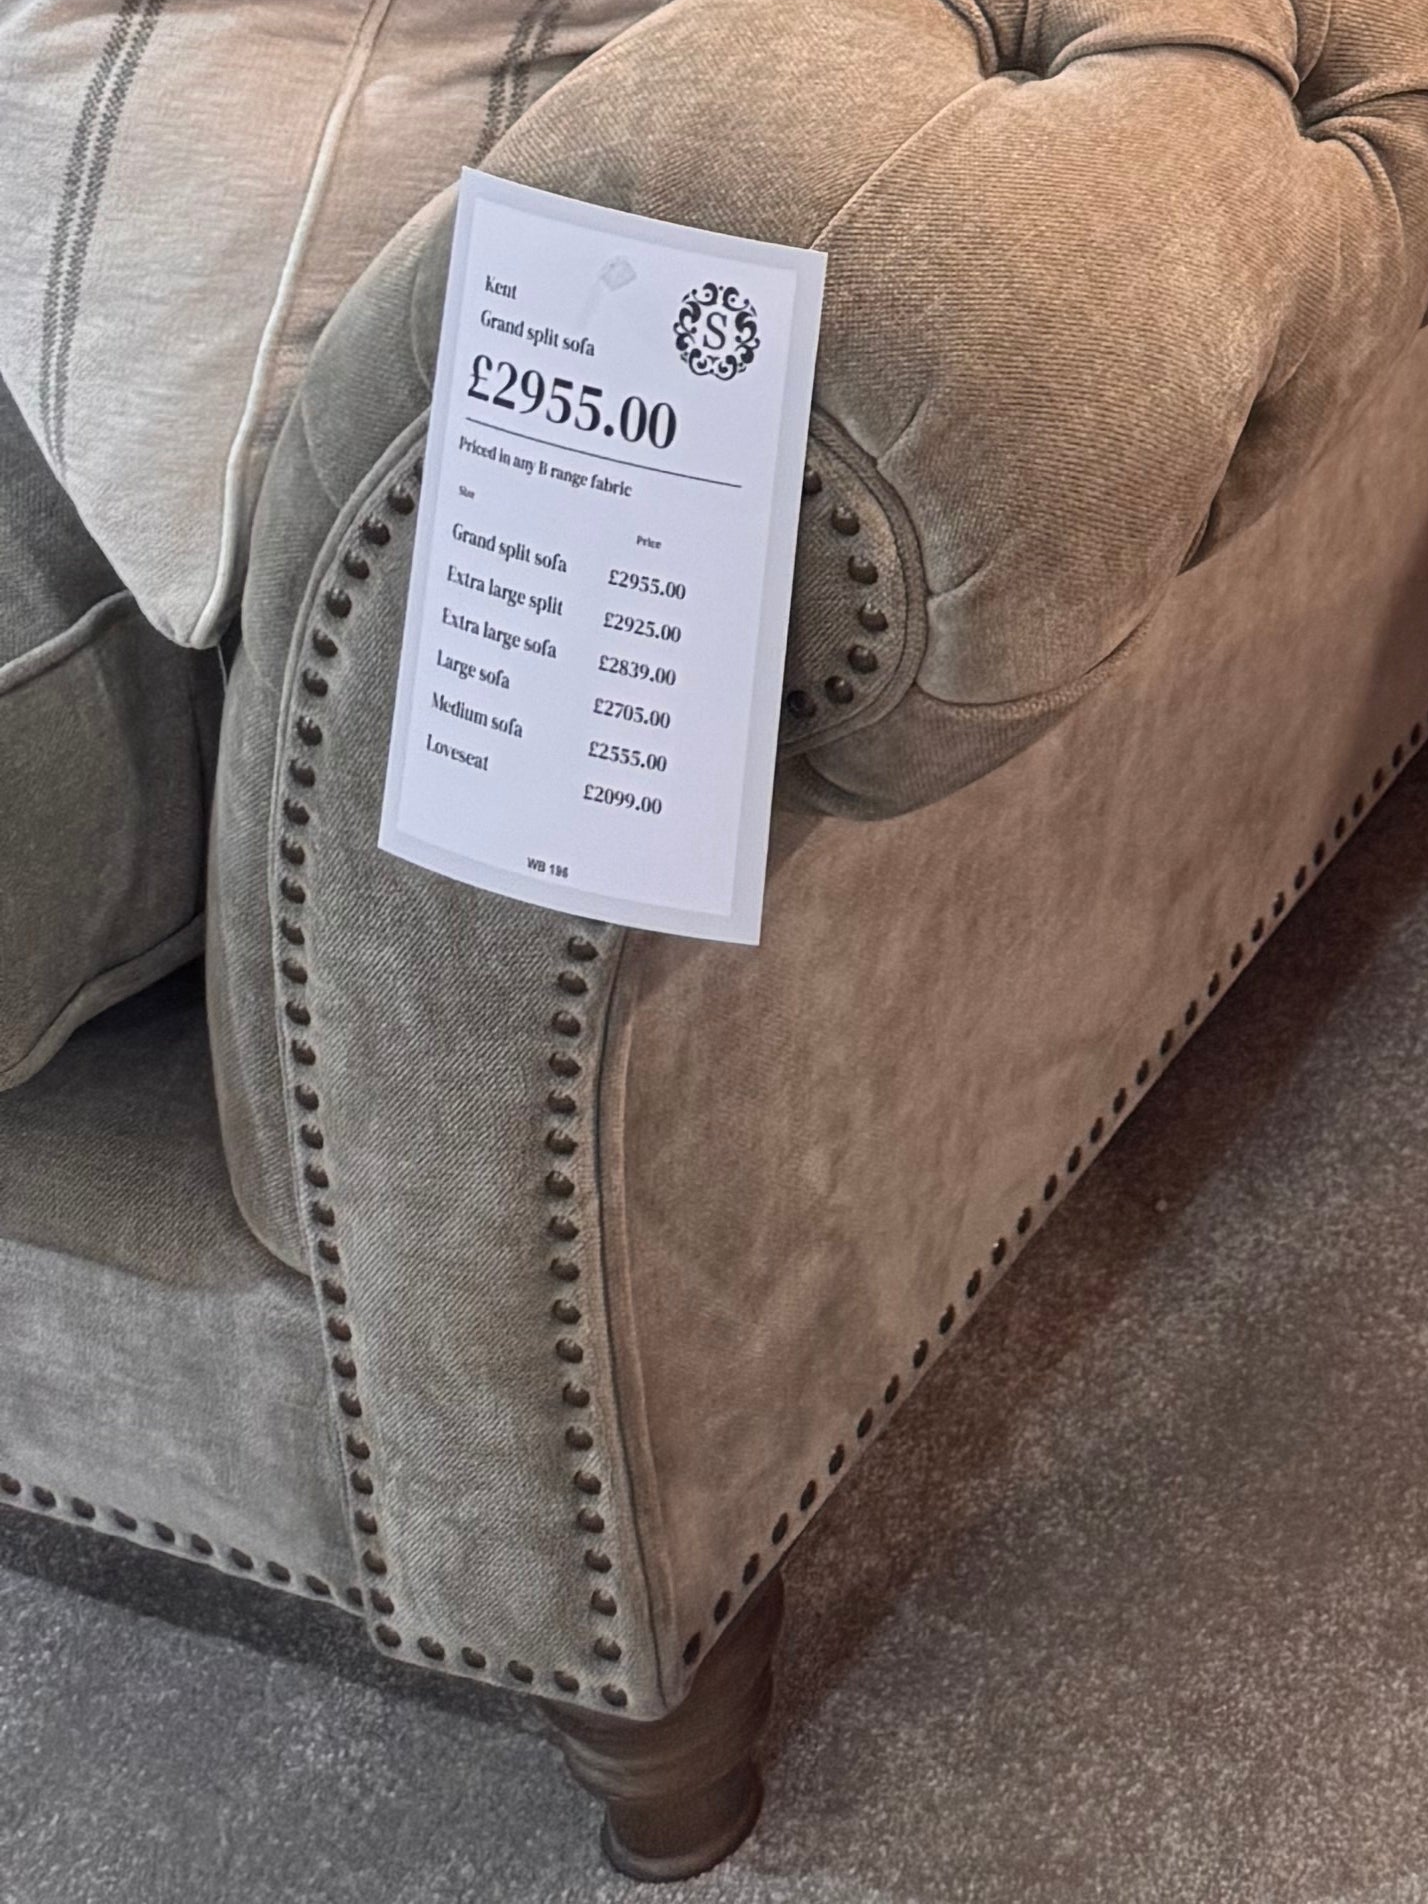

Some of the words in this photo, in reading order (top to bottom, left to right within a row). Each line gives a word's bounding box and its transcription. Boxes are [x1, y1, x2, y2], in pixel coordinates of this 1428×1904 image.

[484, 275, 517, 300] Kent
[481, 309, 525, 338] Grand
[526, 325, 559, 347] split
[562, 336, 596, 357] sofa
[702, 311, 728, 351] S
[467, 354, 677, 449] £2955.00
[458, 435, 498, 461] Priced
[499, 447, 511, 466] in
[513, 456, 536, 476] any
[538, 460, 549, 476] B
[550, 466, 588, 488] range
[590, 474, 633, 497] fabric
[452, 522, 496, 553] Grand
[498, 541, 531, 563] split
[534, 553, 568, 574] sofa
[607, 569, 687, 601] £2955.00
[447, 564, 485, 593] Extra
[488, 578, 526, 608] large
[529, 594, 564, 616] split
[602, 611, 682, 643] £2925.00
[441, 607, 480, 636] Extra
[483, 621, 521, 651] large
[523, 639, 558, 659] sofa
[598, 654, 677, 686] £2839.00
[436, 649, 477, 680] Large
[479, 669, 511, 690] sofa
[592, 697, 671, 729] £2705.00
[431, 691, 489, 728] Medium
[491, 716, 523, 739] sofa
[587, 740, 668, 772] £2555.00
[426, 734, 489, 771] Loveseat
[583, 784, 663, 815] £2099.00
[526, 857, 546, 872] WB
